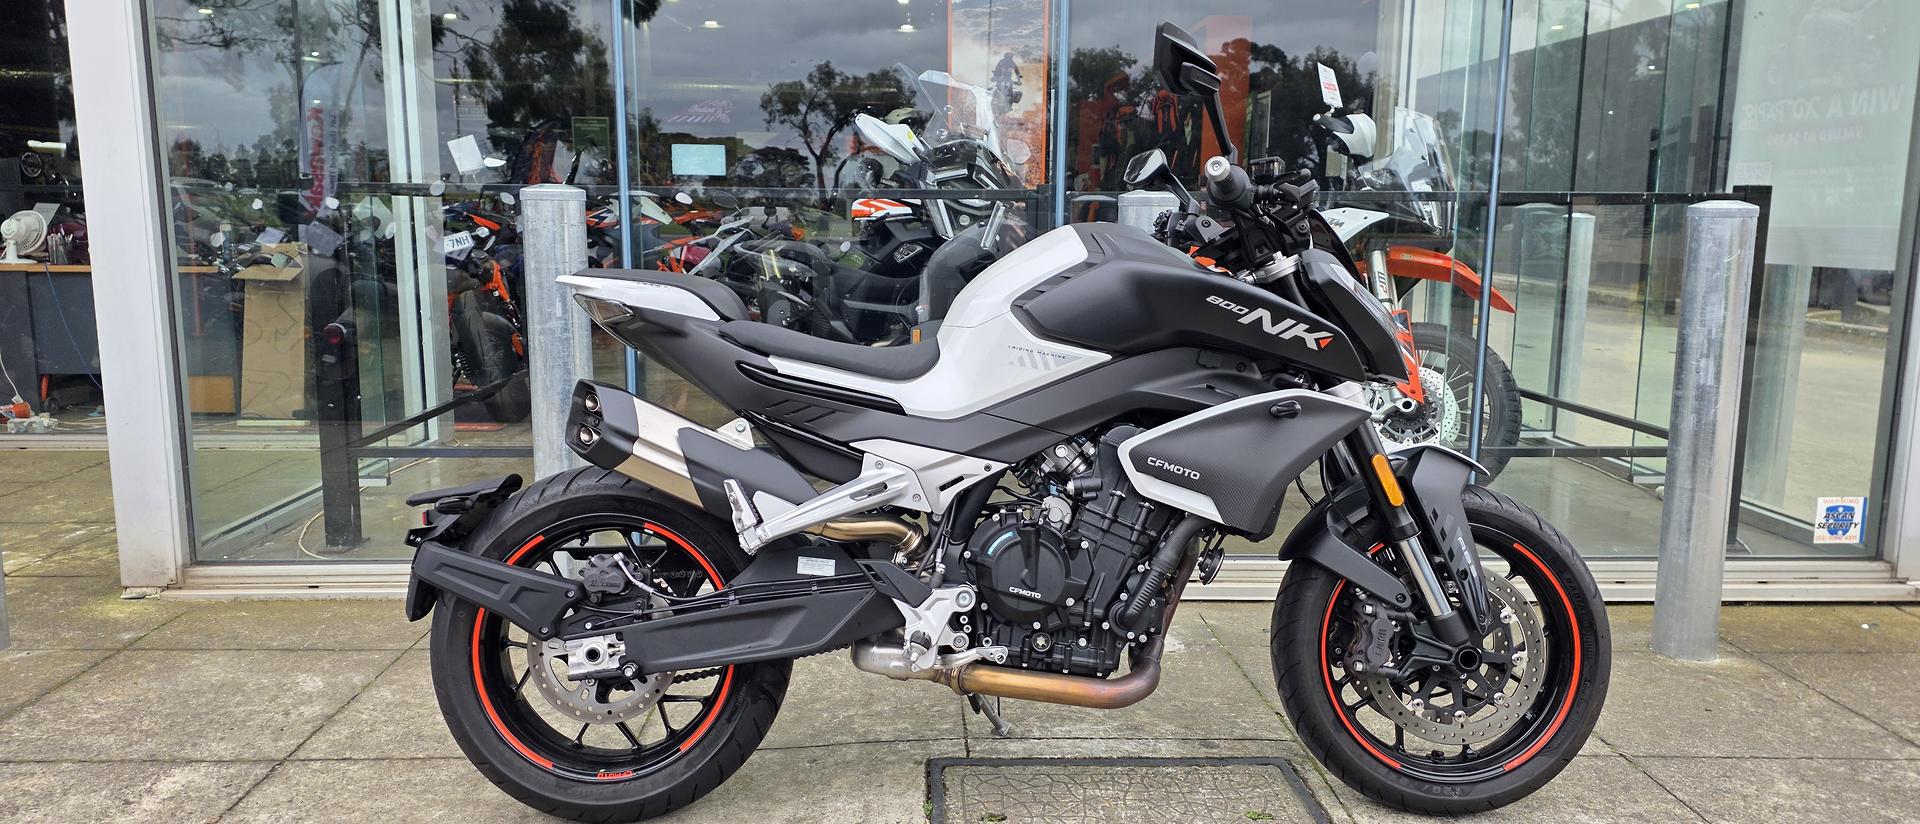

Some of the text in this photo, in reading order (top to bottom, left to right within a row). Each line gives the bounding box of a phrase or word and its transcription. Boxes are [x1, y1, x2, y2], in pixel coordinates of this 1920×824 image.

[1206, 296, 1334, 351] 800 NK
[1147, 457, 1200, 480] CFMOTO
[1009, 586, 1041, 599] CFMOTO
[597, 769, 633, 779] CFMOTO
